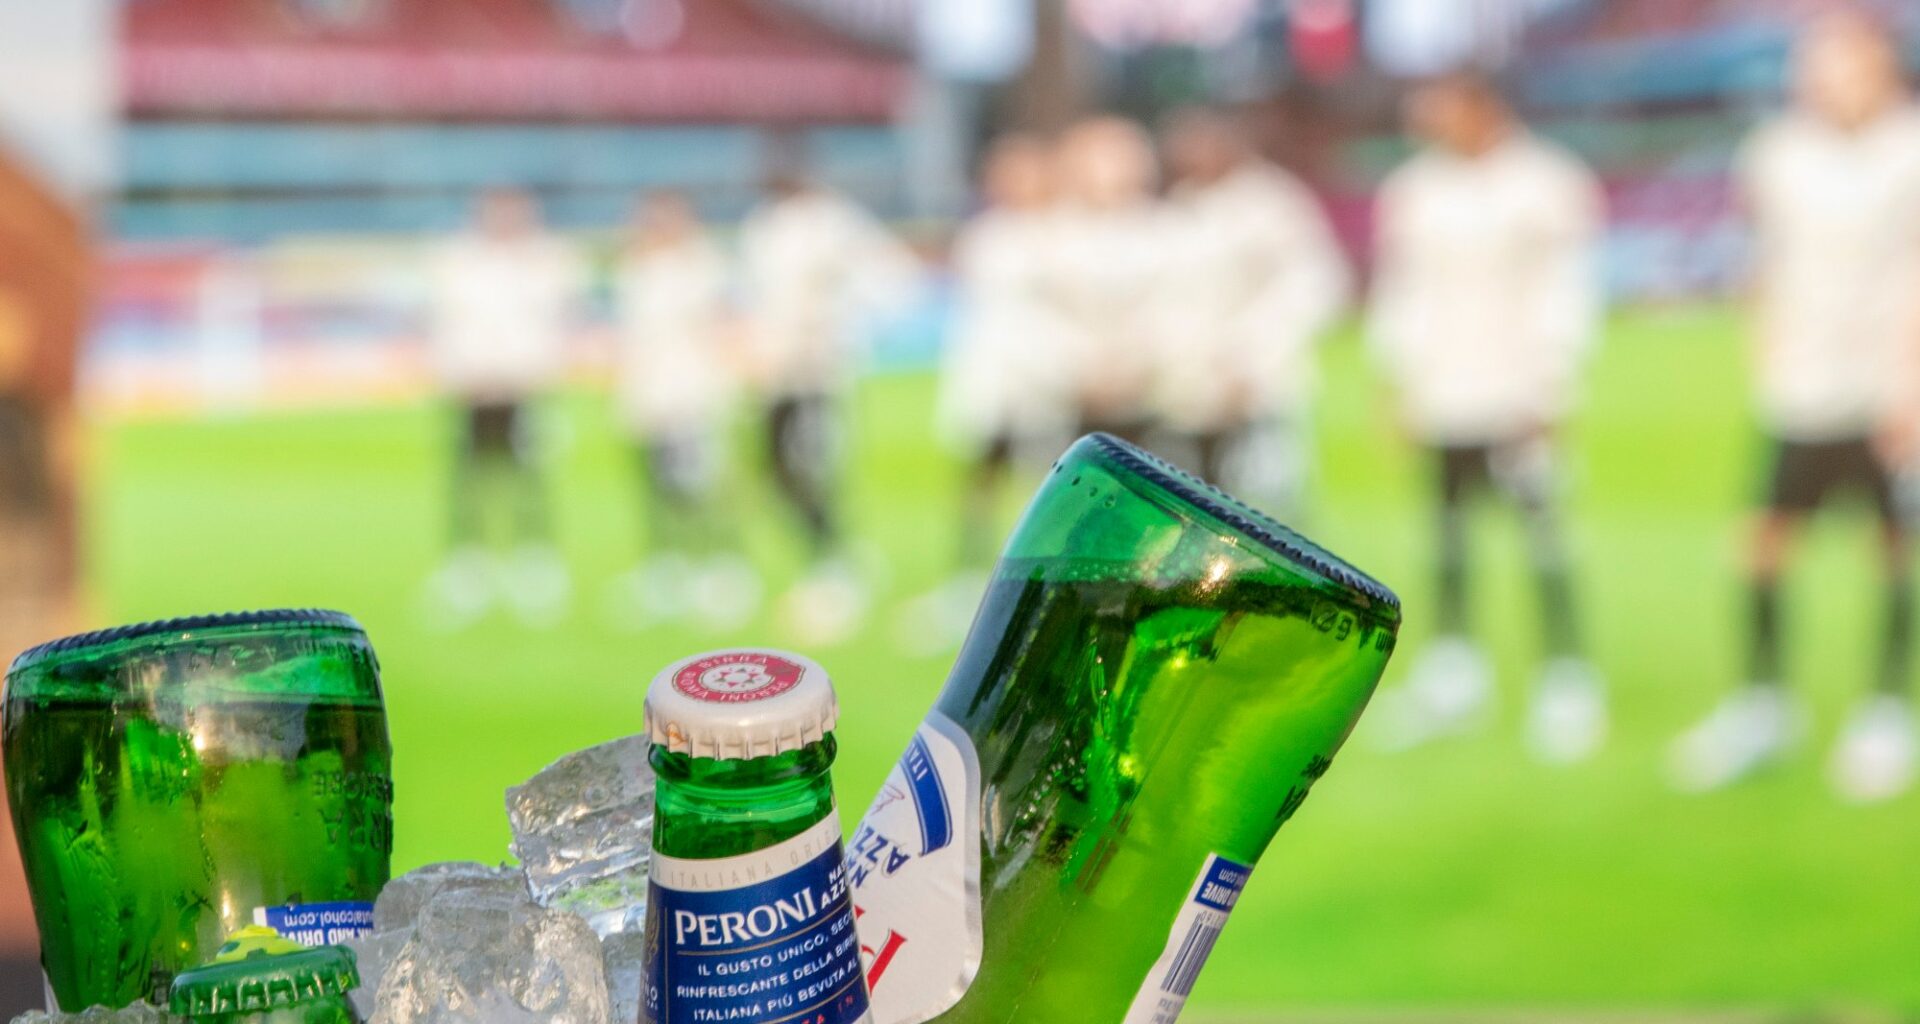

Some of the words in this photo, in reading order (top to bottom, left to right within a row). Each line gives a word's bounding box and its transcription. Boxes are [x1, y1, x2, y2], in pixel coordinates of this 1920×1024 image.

[698, 655, 768, 669] BIRRA
[679, 669, 709, 700] ROMA
[719, 680, 790, 702] PERONI
[670, 860, 774, 889] ITALIANA
[789, 826, 834, 866] ORIG
[853, 822, 911, 875] AZZ
[820, 877, 847, 910] AZZ
[283, 909, 374, 927] utalcohol.com
[674, 886, 817, 946] PERONI
[281, 928, 325, 947] DRIV
[697, 965, 711, 977] IL
[716, 954, 773, 976] GUSTO
[777, 933, 830, 962] UNICO,
[676, 972, 790, 999] RINFRESCANTE
[792, 951, 834, 981] DELLA
[693, 1004, 762, 1022] ITALIANA
[797, 967, 846, 1003] BEVUTA
[847, 957, 858, 974] AL
